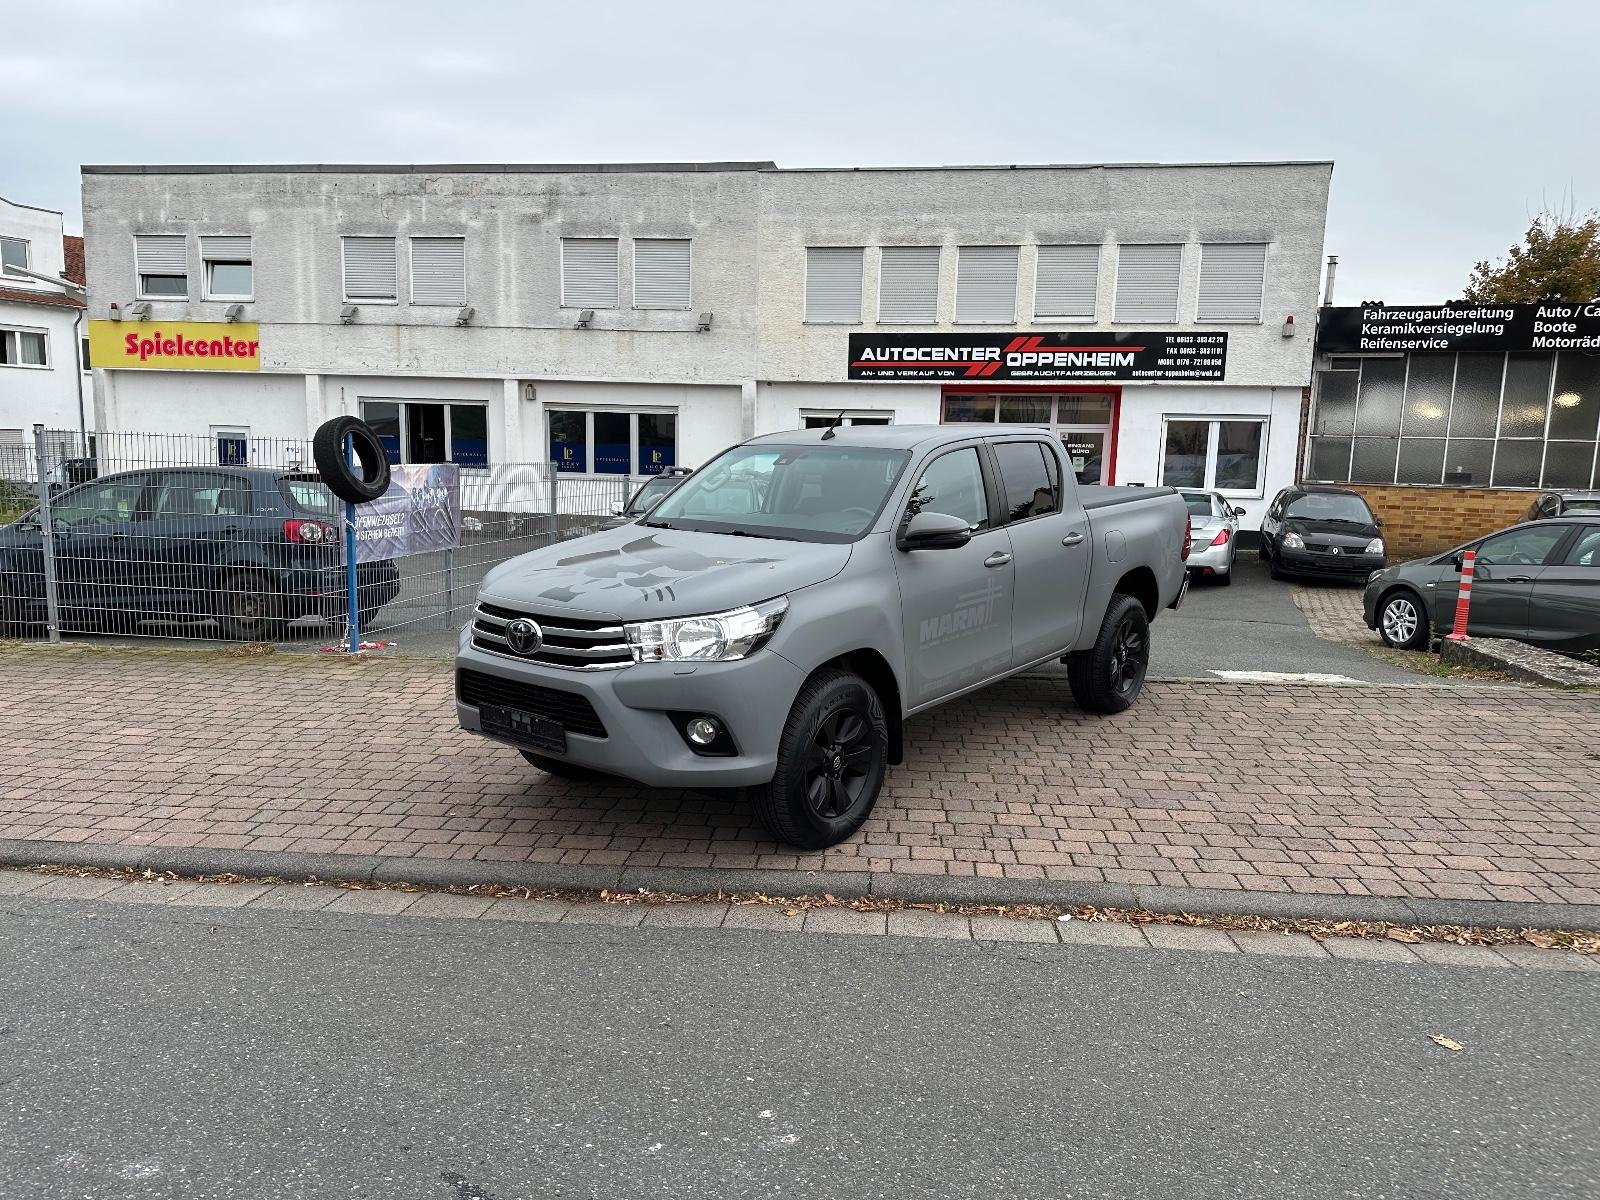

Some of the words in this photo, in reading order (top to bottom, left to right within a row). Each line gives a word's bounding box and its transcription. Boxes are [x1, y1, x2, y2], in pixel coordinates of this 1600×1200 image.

[1363, 308, 1514, 321] Fahrzeugaufbereitung
[1536, 306, 1571, 318] Auto
[1574, 305, 1582, 318] /
[1361, 323, 1504, 335] Keramikversiegelung
[1533, 321, 1577, 333] Boote
[124, 331, 260, 361] Spielcenter
[1165, 336, 1175, 344] TEL
[1360, 337, 1448, 349] Reifenservice
[861, 347, 1001, 361] AUTOCENTER
[1166, 347, 1178, 355] FAX
[1006, 352, 1135, 367] OPPENHEIM
[1157, 358, 1175, 366] MOBIL
